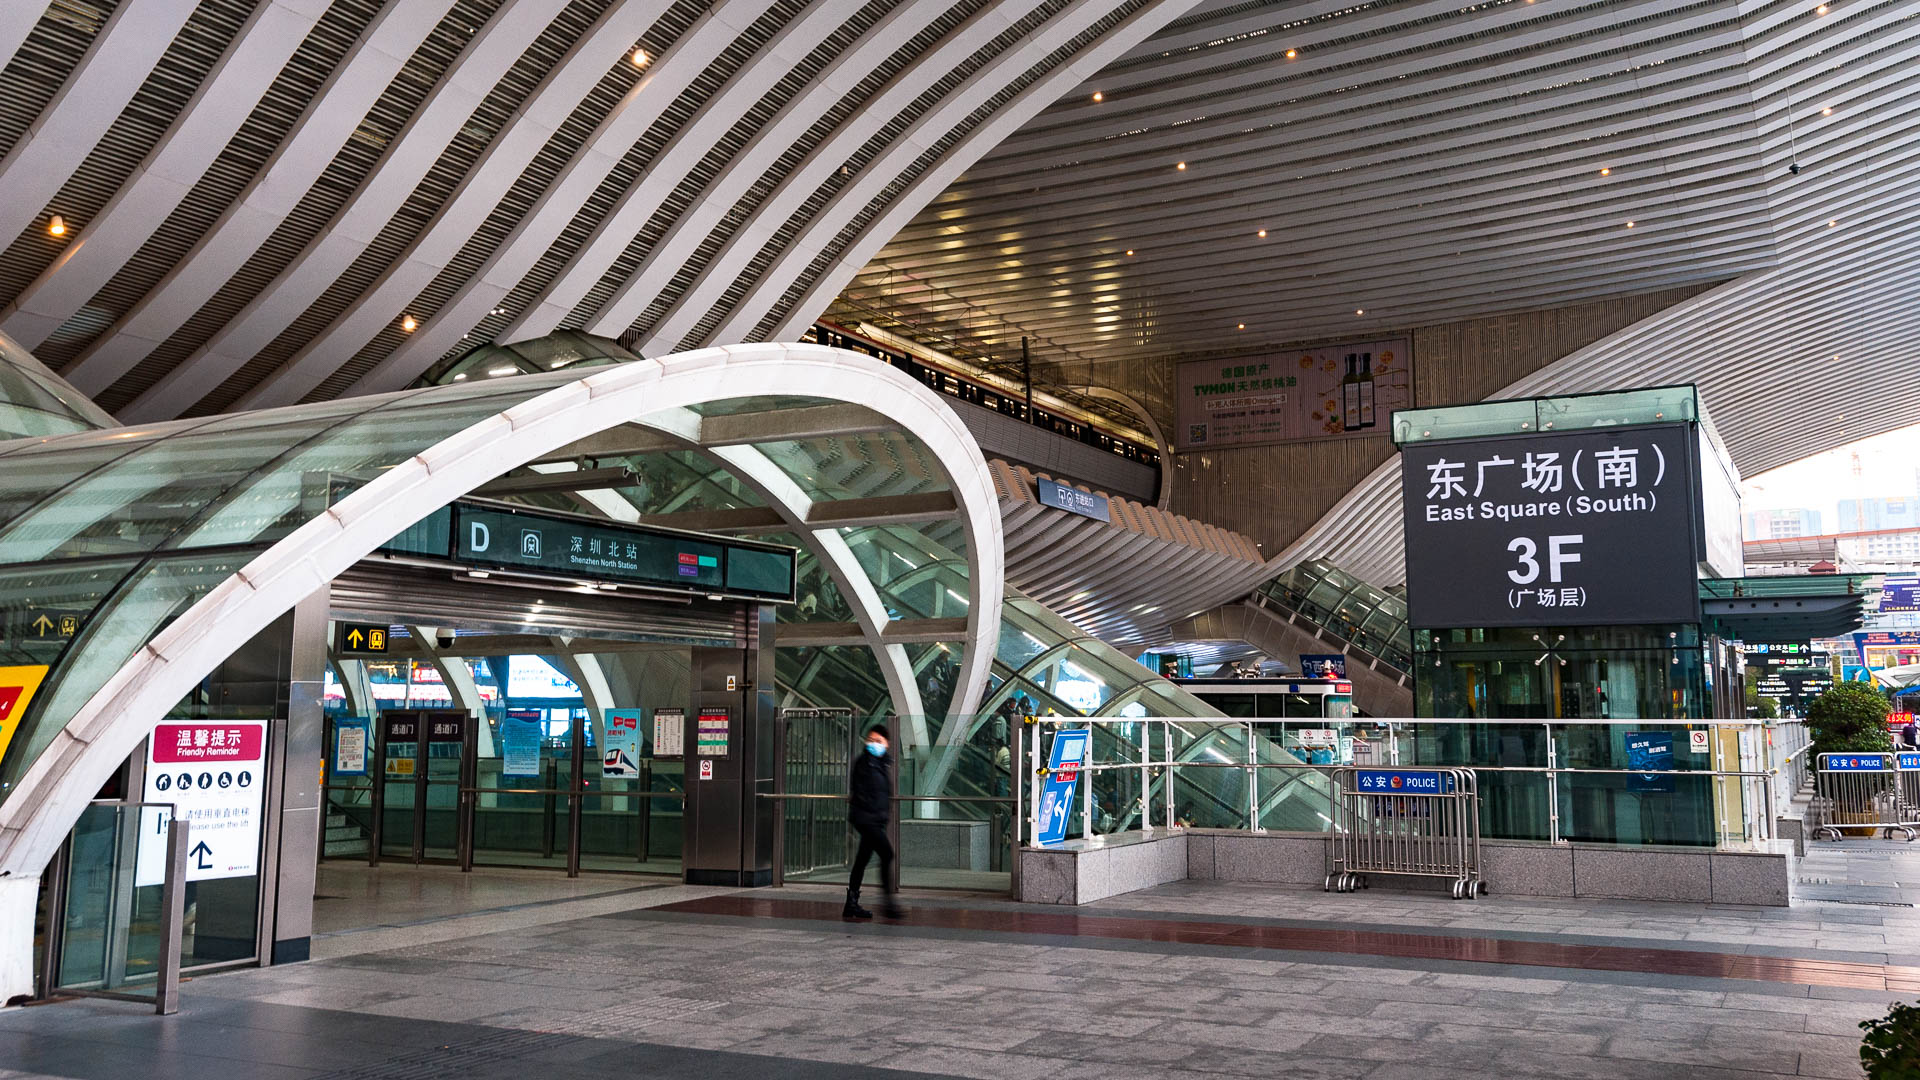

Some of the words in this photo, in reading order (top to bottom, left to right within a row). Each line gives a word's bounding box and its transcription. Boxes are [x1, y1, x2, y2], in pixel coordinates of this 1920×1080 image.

[1238, 376, 1297, 392] 天然核桃油
[1426, 503, 1474, 522] East
[1480, 501, 1561, 522] Square
[1566, 491, 1656, 517] (South)
[471, 521, 490, 552] D
[570, 535, 638, 560] 深圳北站
[570, 555, 600, 566] Shenzhen
[600, 558, 617, 568] North
[617, 560, 638, 570] Station
[1507, 534, 1585, 585] 3F
[1312, 660, 1345, 674] 西场
[391, 723, 414, 735] 通道门
[434, 723, 459, 735] 通道门
[176, 729, 242, 747] 温馨提示
[176, 747, 205, 757] Friendly
[206, 746, 240, 756] Reminder
[1831, 758, 1848, 767] 公安
[1860, 759, 1881, 767] POLICE
[1362, 775, 1386, 788] 公安
[1406, 777, 1436, 788] POLICE
[1044, 793, 1055, 814] 5
[189, 820, 209, 831] lease
